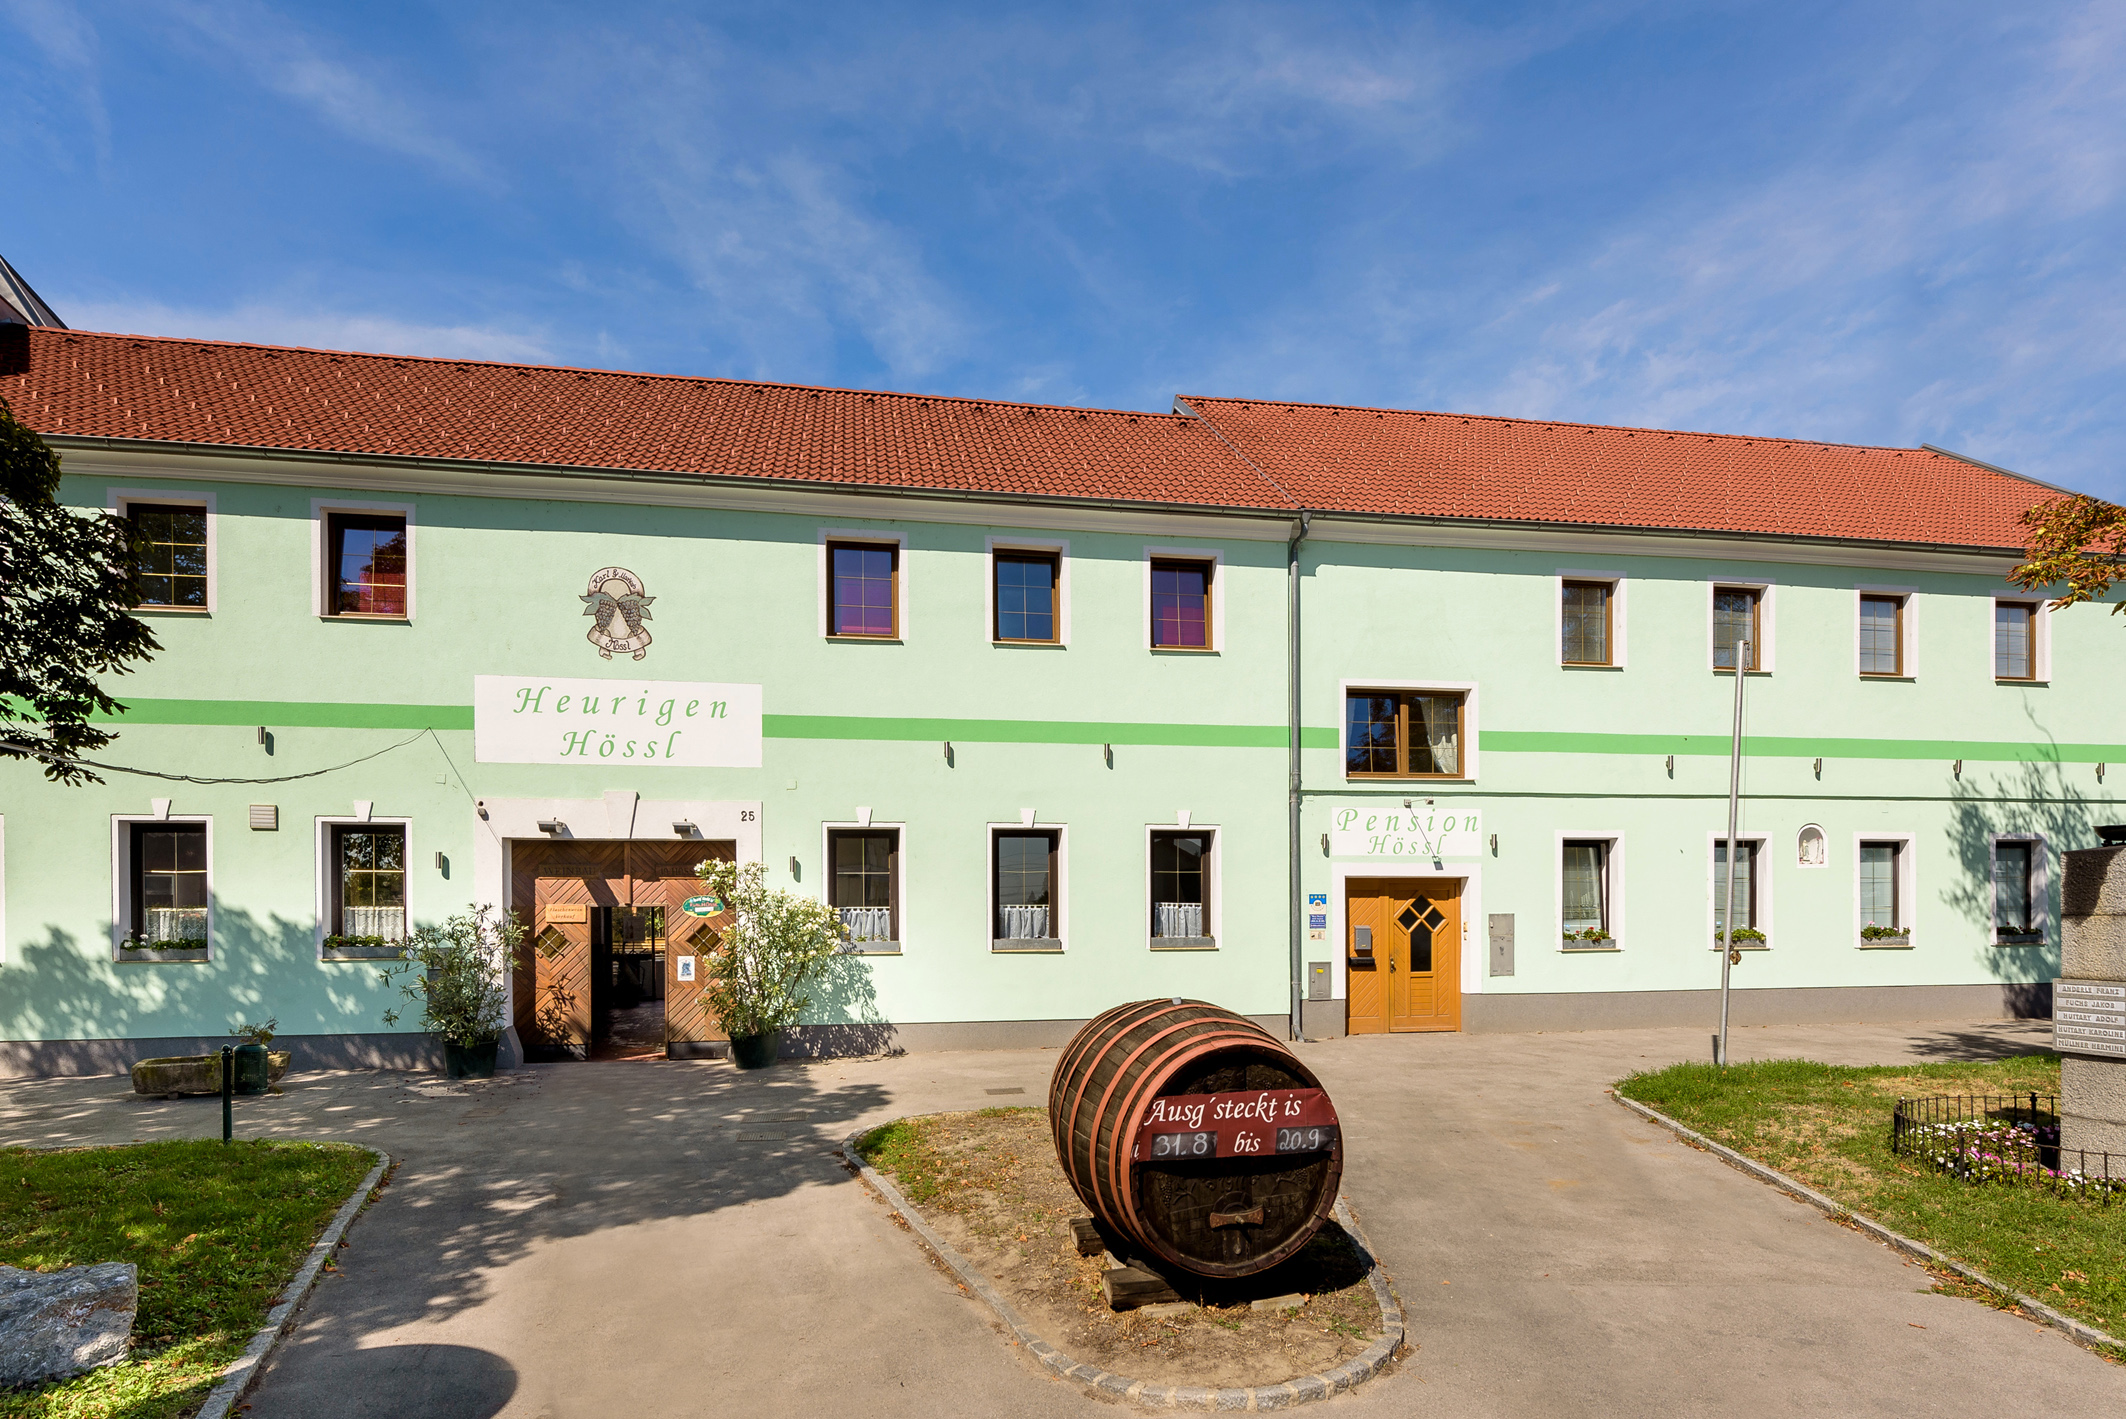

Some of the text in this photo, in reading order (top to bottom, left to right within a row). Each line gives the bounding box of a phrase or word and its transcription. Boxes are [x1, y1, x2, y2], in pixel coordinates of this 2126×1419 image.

[513, 685, 729, 727] Heurigen
[559, 729, 682, 759] Hössl
[740, 810, 756, 823] 25
[1336, 807, 1479, 833] Pension
[1367, 833, 1448, 856] Hössl
[543, 866, 597, 876] WEINBAU
[2062, 985, 2120, 995] ANDERLE FRANZ
[2065, 999, 2116, 1009] FUCHS JAKOB
[2095, 1015, 2119, 1024] ADOLF
[2088, 1029, 2124, 1039] KAROLINE
[2091, 1042, 2124, 1053] HERMINE
[1284, 1093, 1302, 1116] is
[1233, 1131, 1261, 1153] bis
[1279, 1128, 1320, 1150] 20.9
